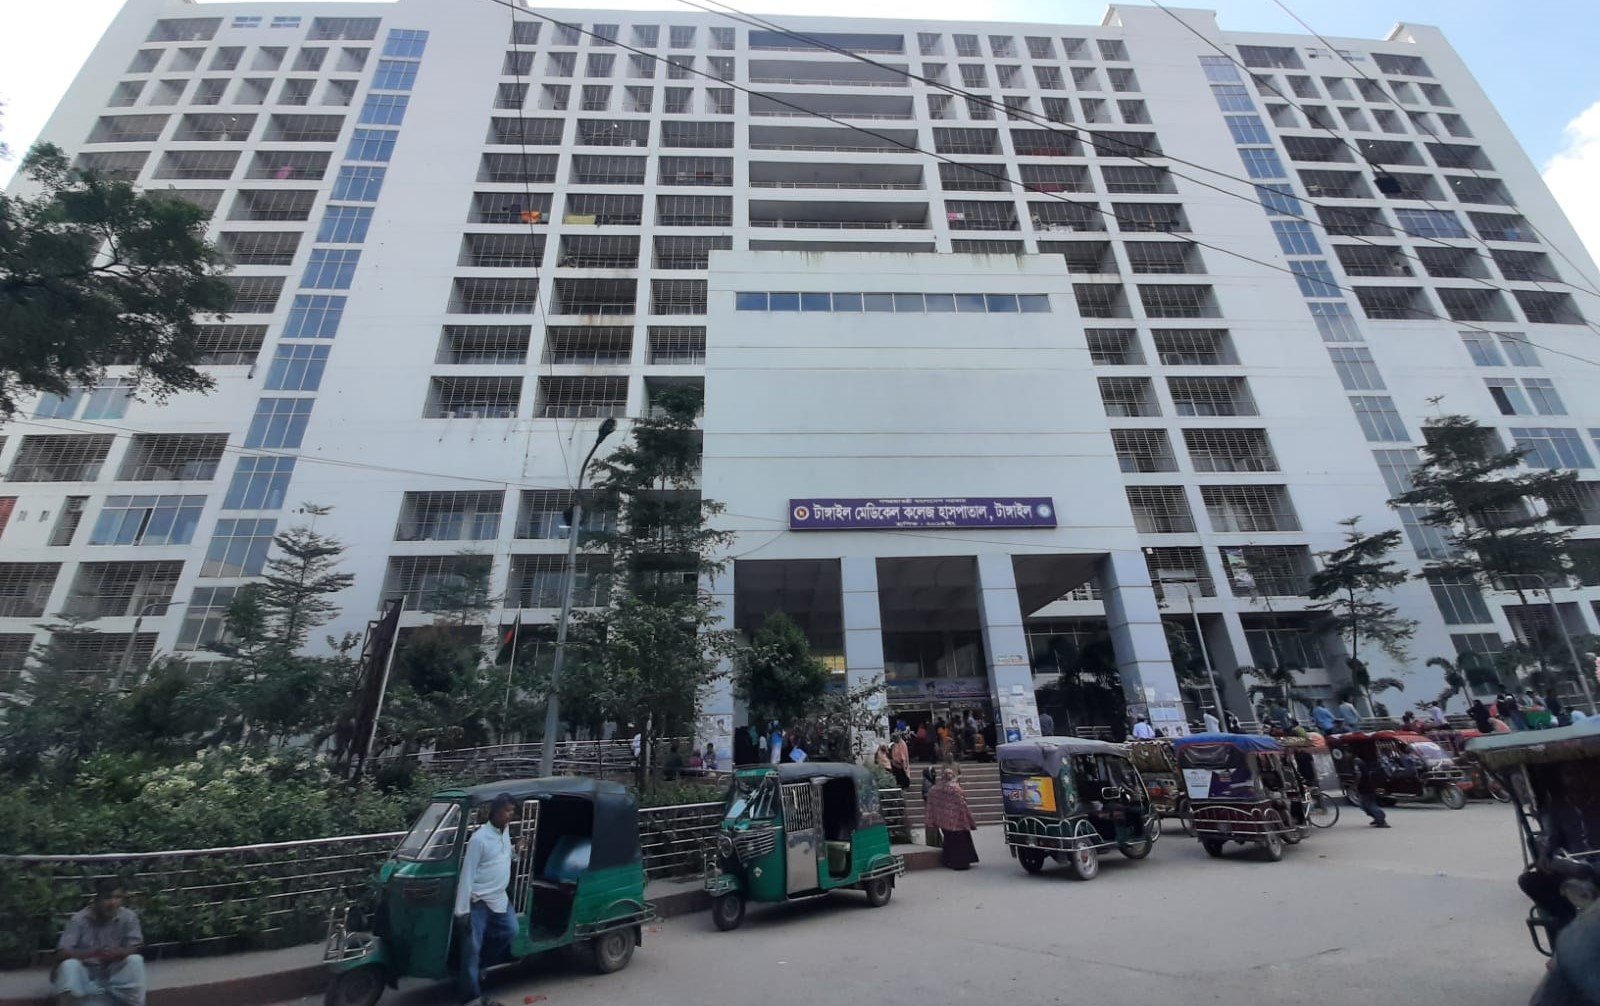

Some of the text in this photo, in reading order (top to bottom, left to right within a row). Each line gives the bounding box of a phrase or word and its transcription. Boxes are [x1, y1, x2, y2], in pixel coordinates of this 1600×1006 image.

[813, 503, 852, 520] টাঙ্গাইল
[855, 502, 900, 520] মেডিকেল
[902, 506, 936, 520] কলেজ
[994, 501, 1032, 519] টাঙ্গাইল
